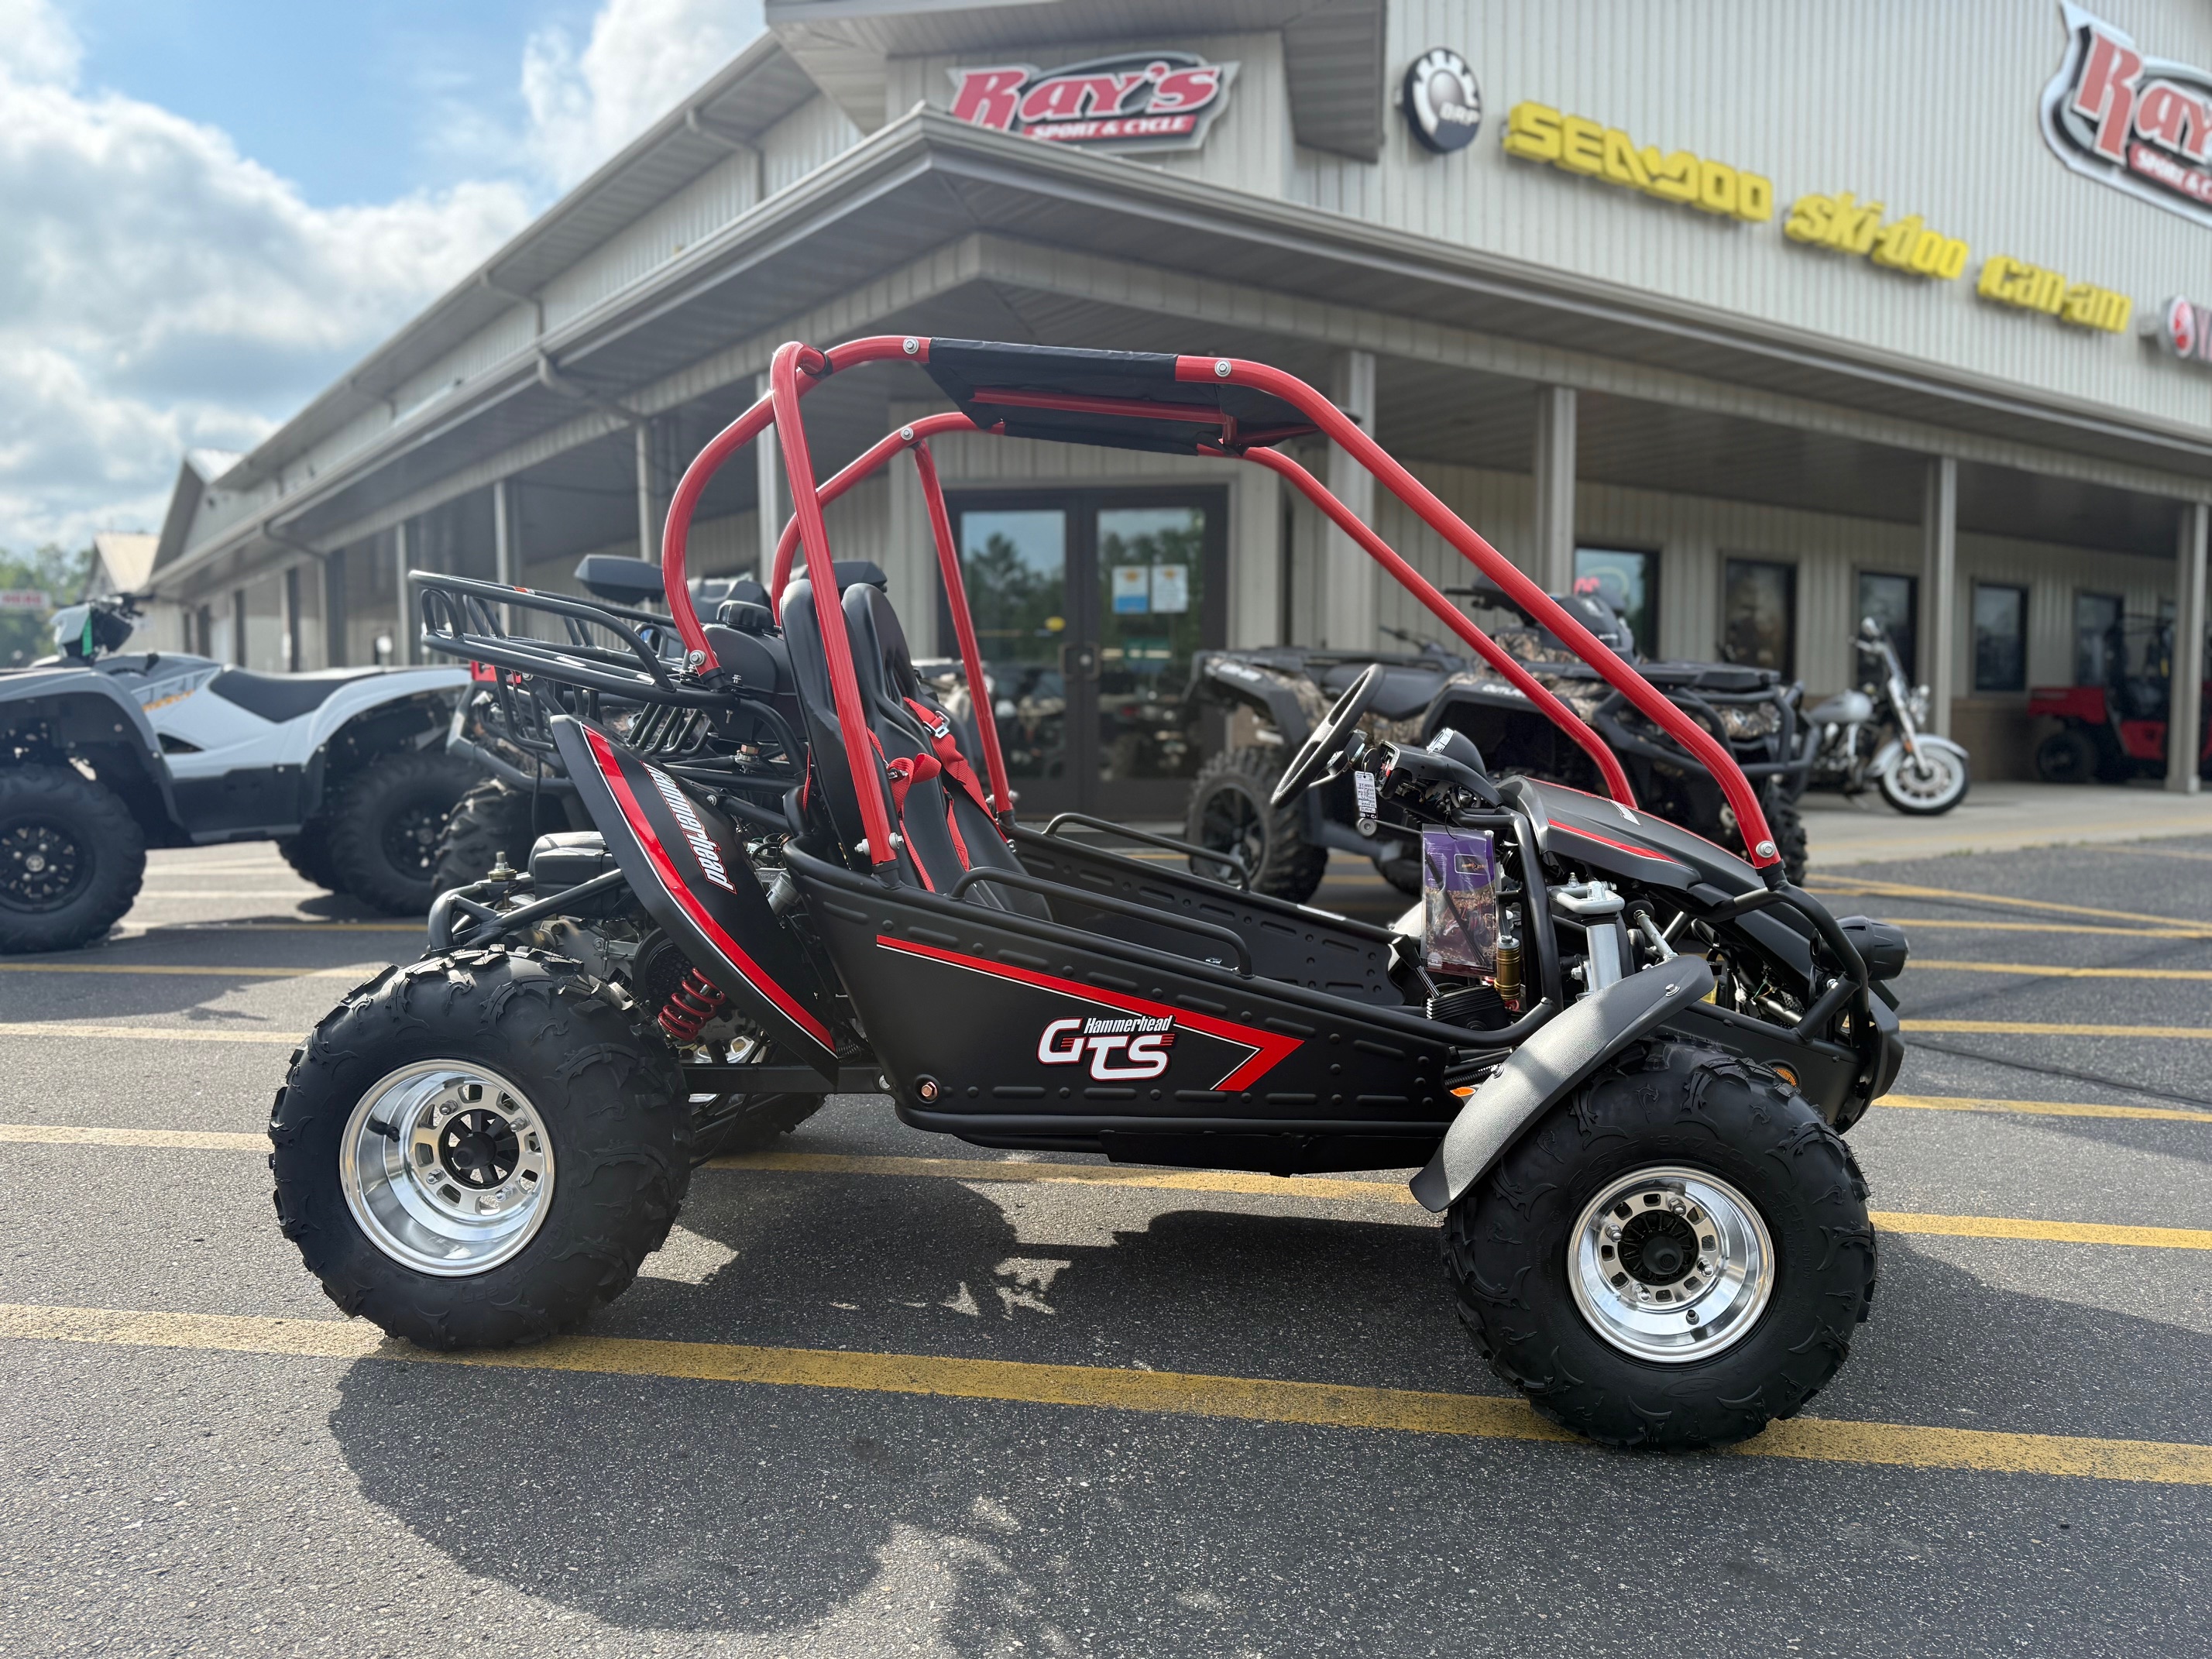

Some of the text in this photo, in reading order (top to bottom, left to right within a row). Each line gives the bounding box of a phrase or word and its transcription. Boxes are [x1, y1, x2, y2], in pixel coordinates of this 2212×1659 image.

[950, 62, 1223, 132] Ray's
[1032, 115, 1188, 138] SPORT & CYCLE
[641, 761, 736, 893] Hammerhead
[1036, 1017, 1176, 1082] GTS
[1083, 1015, 1173, 1034] Hammerhead
